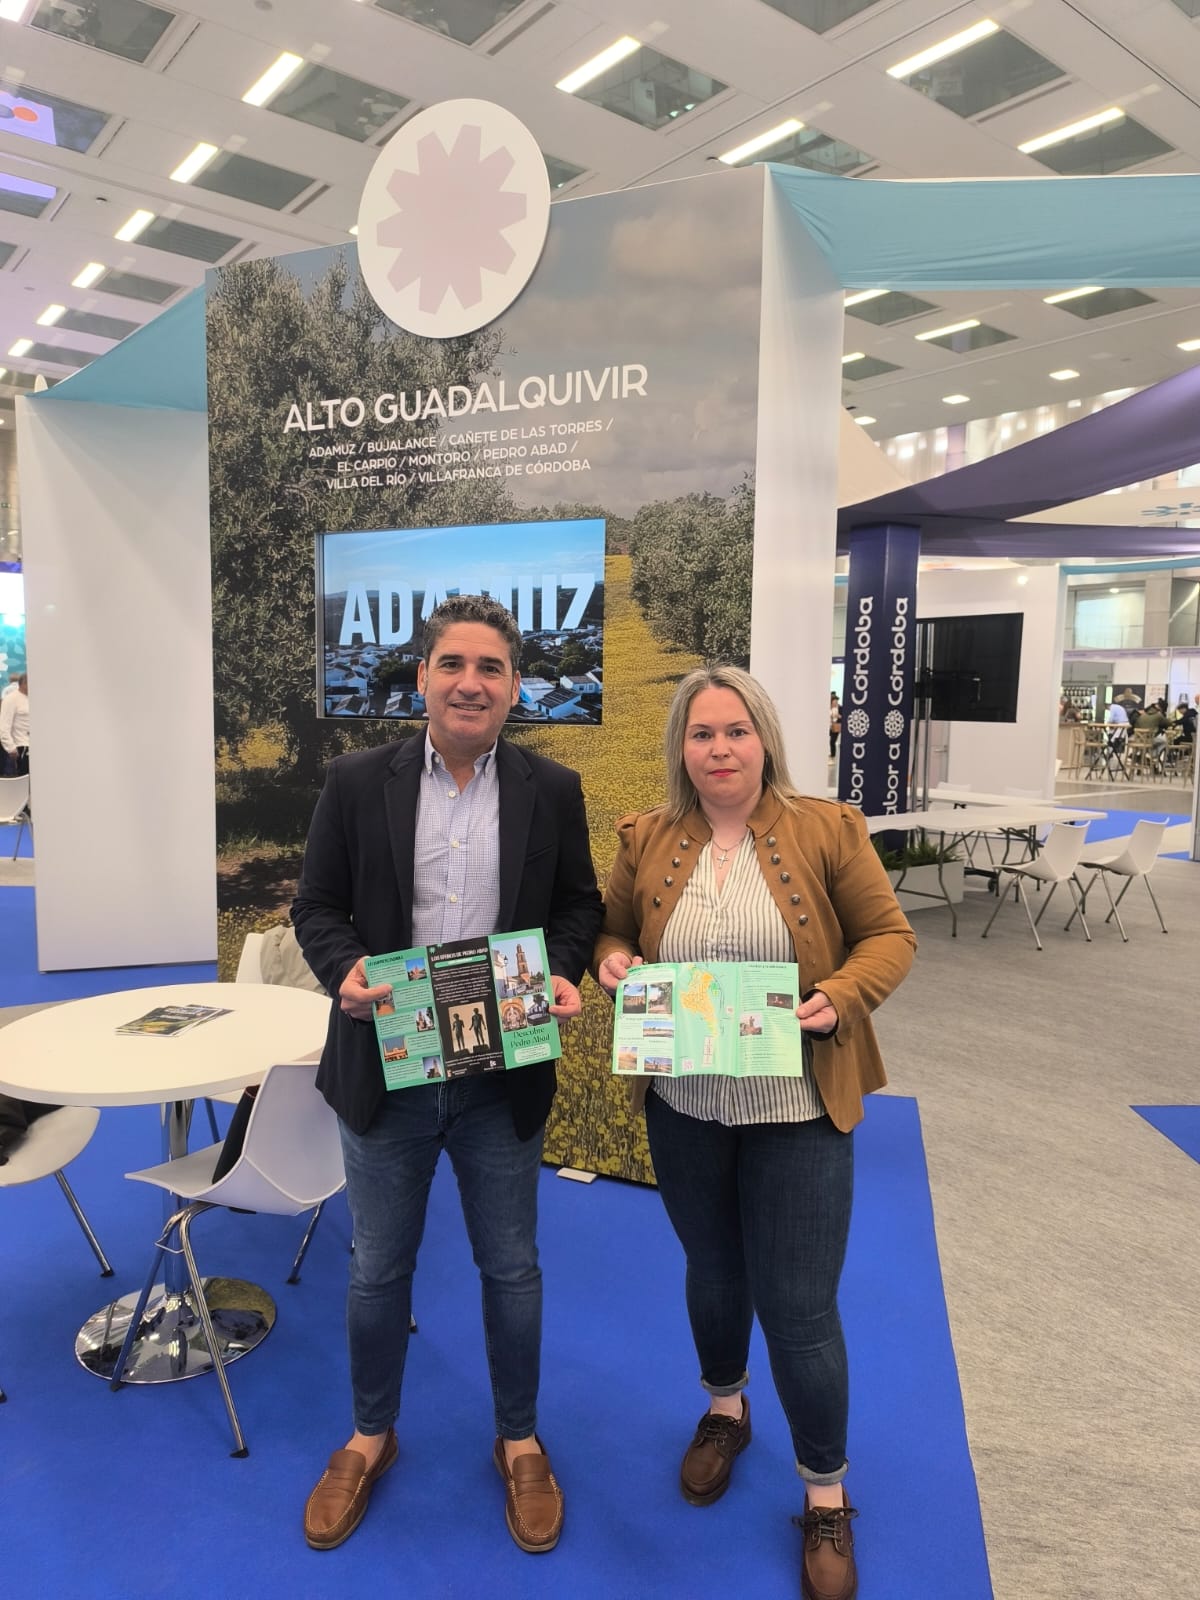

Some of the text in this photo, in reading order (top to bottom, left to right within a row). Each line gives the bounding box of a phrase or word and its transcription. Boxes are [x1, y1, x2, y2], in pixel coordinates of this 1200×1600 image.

[283, 363, 649, 434] ALTO GUADALQUIVIR
[309, 443, 356, 458] ADAMUZ
[367, 436, 437, 453] BUJALANCE
[449, 430, 498, 445] CAÑETE
[501, 428, 518, 441] DE
[521, 426, 546, 439] LAS
[549, 420, 603, 436] TORRES
[327, 477, 359, 489] VILLA
[361, 475, 384, 487] DEL
[386, 472, 406, 486] RÍO
[418, 467, 502, 484] VILLAFRANCA
[505, 464, 523, 477] DE
[526, 459, 592, 475] CÓRDOBA
[337, 461, 351, 473] EL
[354, 457, 397, 471] CARPIO
[408, 451, 471, 466] MONTORO
[483, 446, 527, 461] PEDRO
[530, 442, 568, 457] ABAD
[851, 596, 874, 706] Córdoba
[888, 597, 909, 706] Córdoba
[852, 742, 866, 759] a
[888, 743, 901, 760] a
